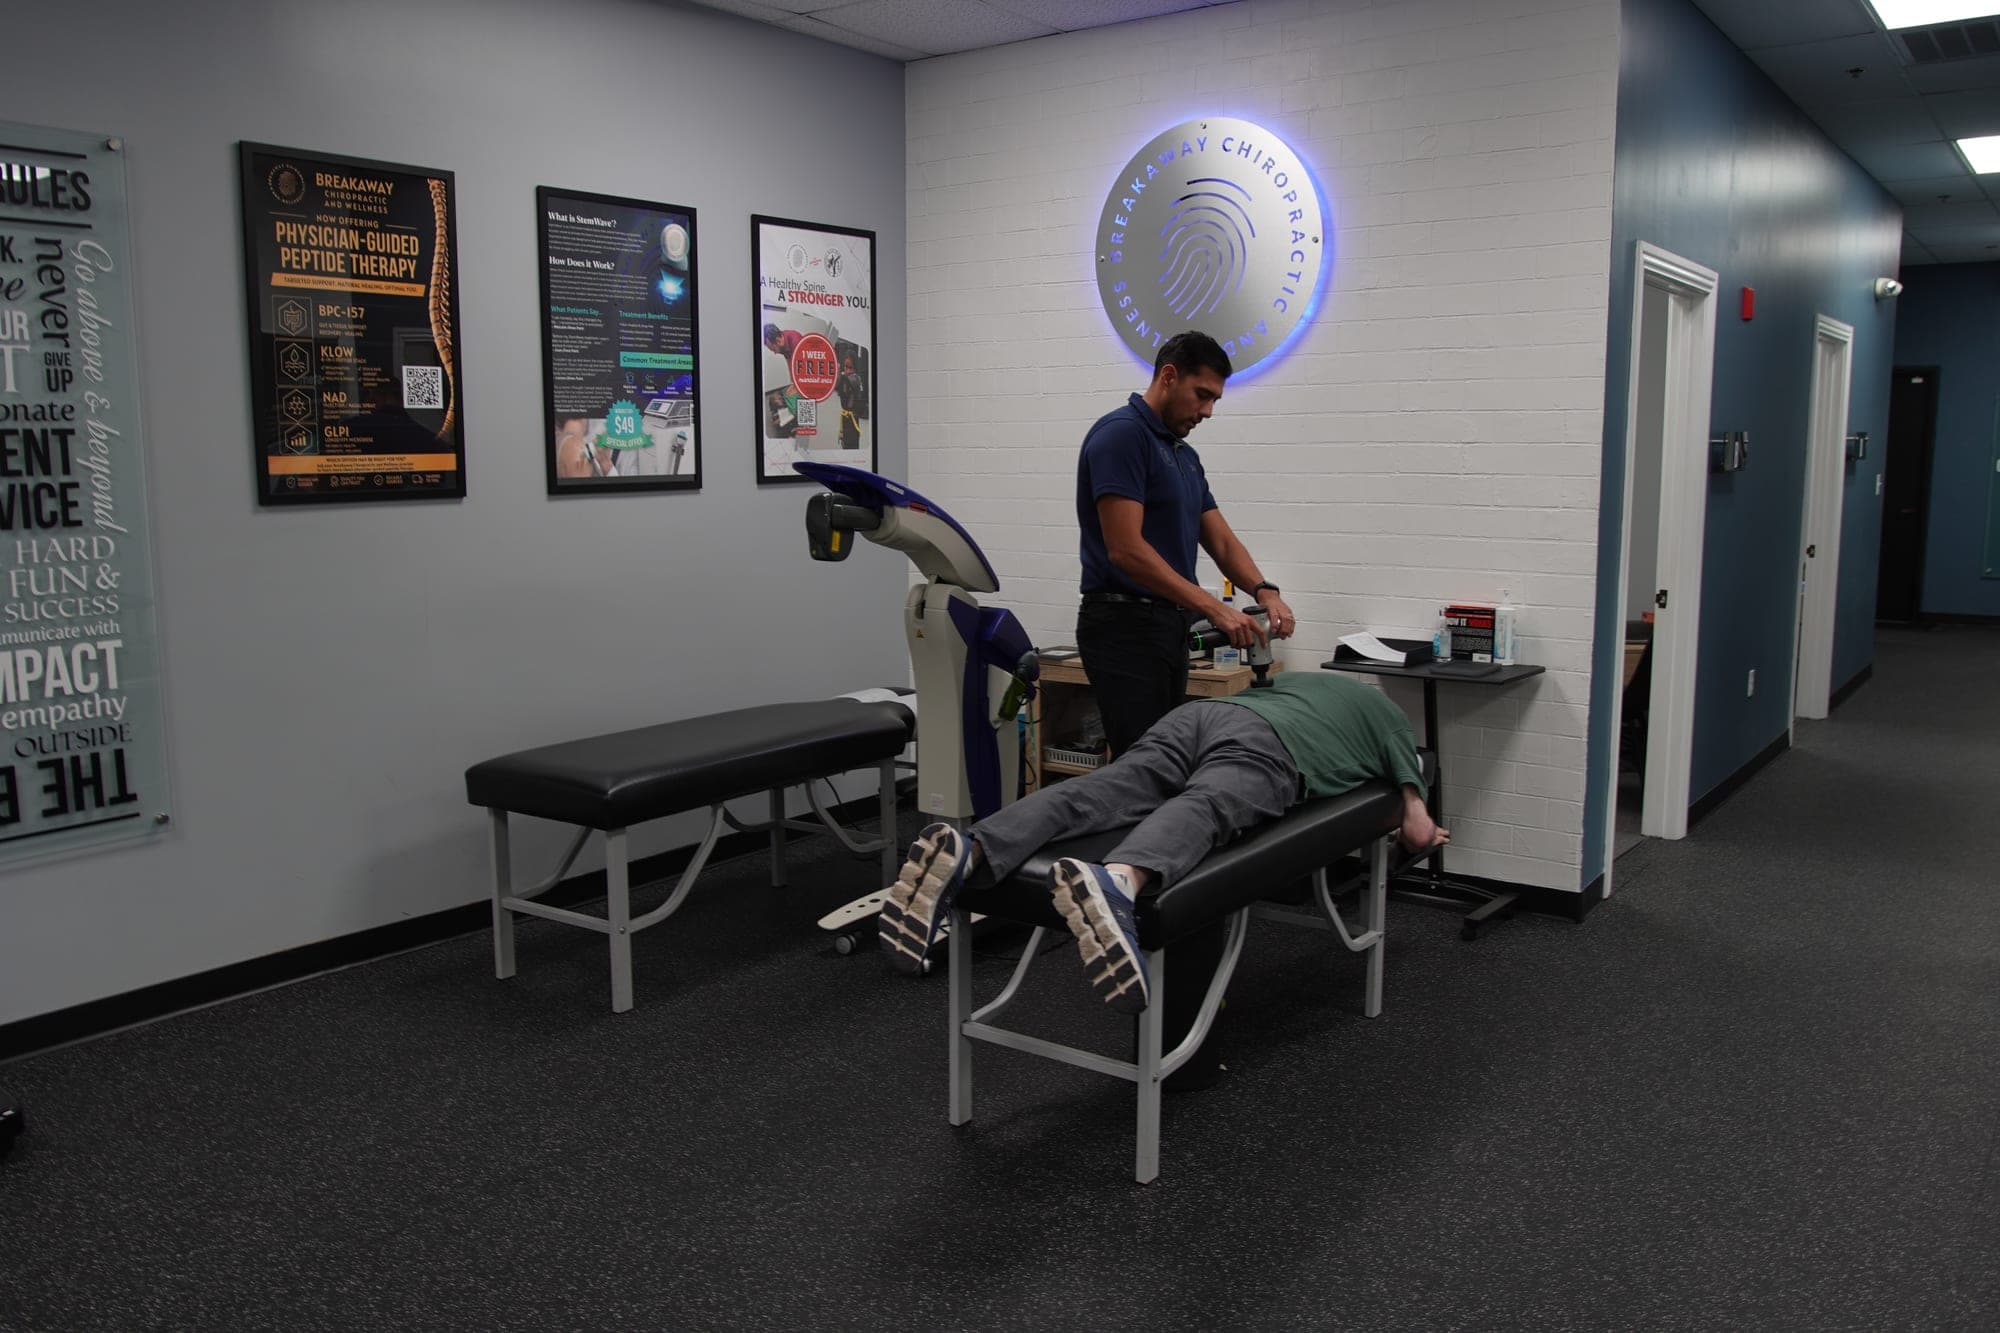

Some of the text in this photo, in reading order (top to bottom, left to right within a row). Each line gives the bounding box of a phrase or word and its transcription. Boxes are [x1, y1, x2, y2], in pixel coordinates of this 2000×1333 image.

[315, 172, 394, 195] BREAKAWAY
[324, 190, 387, 205] CHIROPRACTIC
[324, 200, 388, 214] AND WELLNESS
[1110, 136, 1208, 263] BREAKAWAY
[316, 214, 379, 228] NOW OFFERING
[548, 211, 568, 222] What
[569, 214, 575, 222] is
[1222, 137, 1306, 313] CHIROPRACTIC
[275, 221, 420, 256] PHYSICIAN-GUIDED
[280, 246, 417, 279] PEPTIDE THERAPY
[549, 255, 565, 266] How
[567, 257, 585, 267] Does
[592, 260, 615, 271] Work?
[35, 237, 70, 348] never
[769, 276, 802, 291] Healthy
[777, 289, 870, 310] A STRONGER YOU.
[320, 345, 354, 357] KLOW
[1222, 319, 1269, 357] AND
[44, 351, 72, 367] GIVE
[796, 360, 835, 376] FREE
[806, 350, 826, 360] WEEK
[46, 367, 73, 393] UP
[70, 240, 128, 533] Go above & beyond
[322, 391, 347, 403] NAD
[615, 416, 634, 435] $49
[16, 535, 115, 564] HARD
[9, 563, 120, 598] FUN &
[4, 594, 119, 623] SUCCESS
[0, 619, 121, 646] municate with
[2, 692, 128, 730] empathy
[14, 723, 133, 758] OUTSIDE
[36, 748, 138, 818] THE
